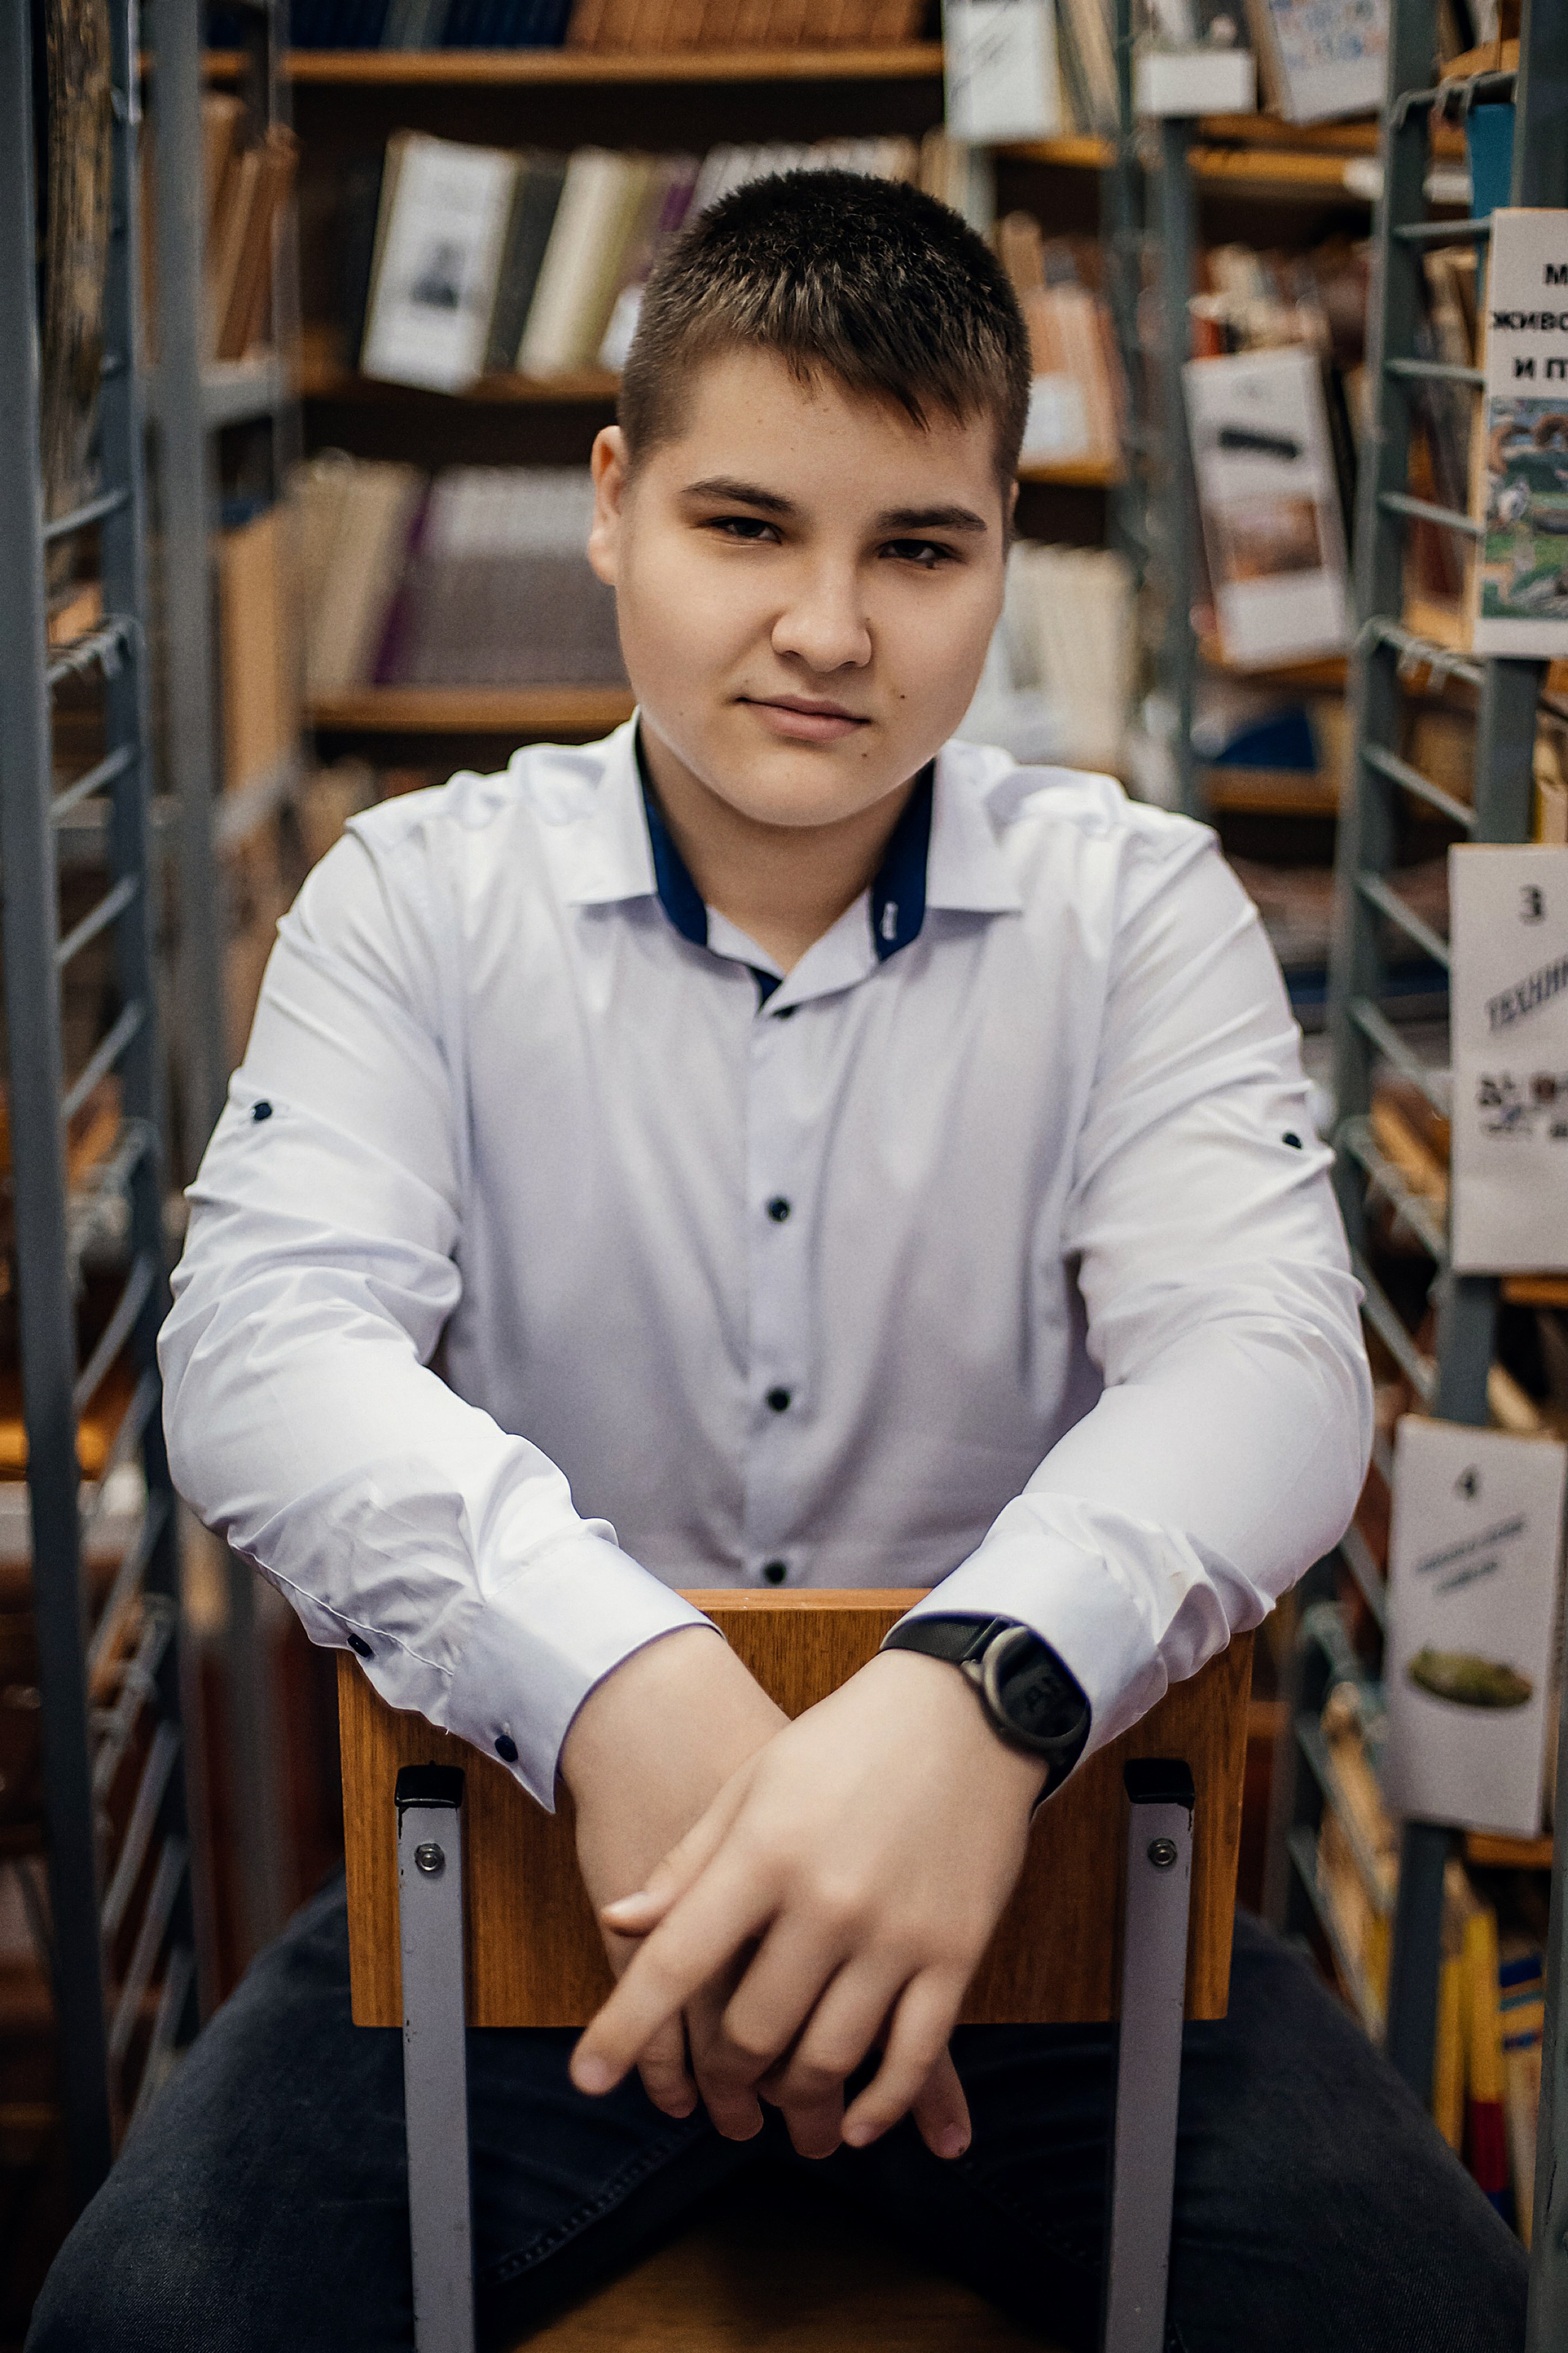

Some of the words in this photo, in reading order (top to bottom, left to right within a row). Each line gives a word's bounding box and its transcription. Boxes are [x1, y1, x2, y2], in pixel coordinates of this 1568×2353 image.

[1514, 358, 1534, 377] И
[1547, 358, 1568, 378] П
[1520, 886, 1544, 923] 3
